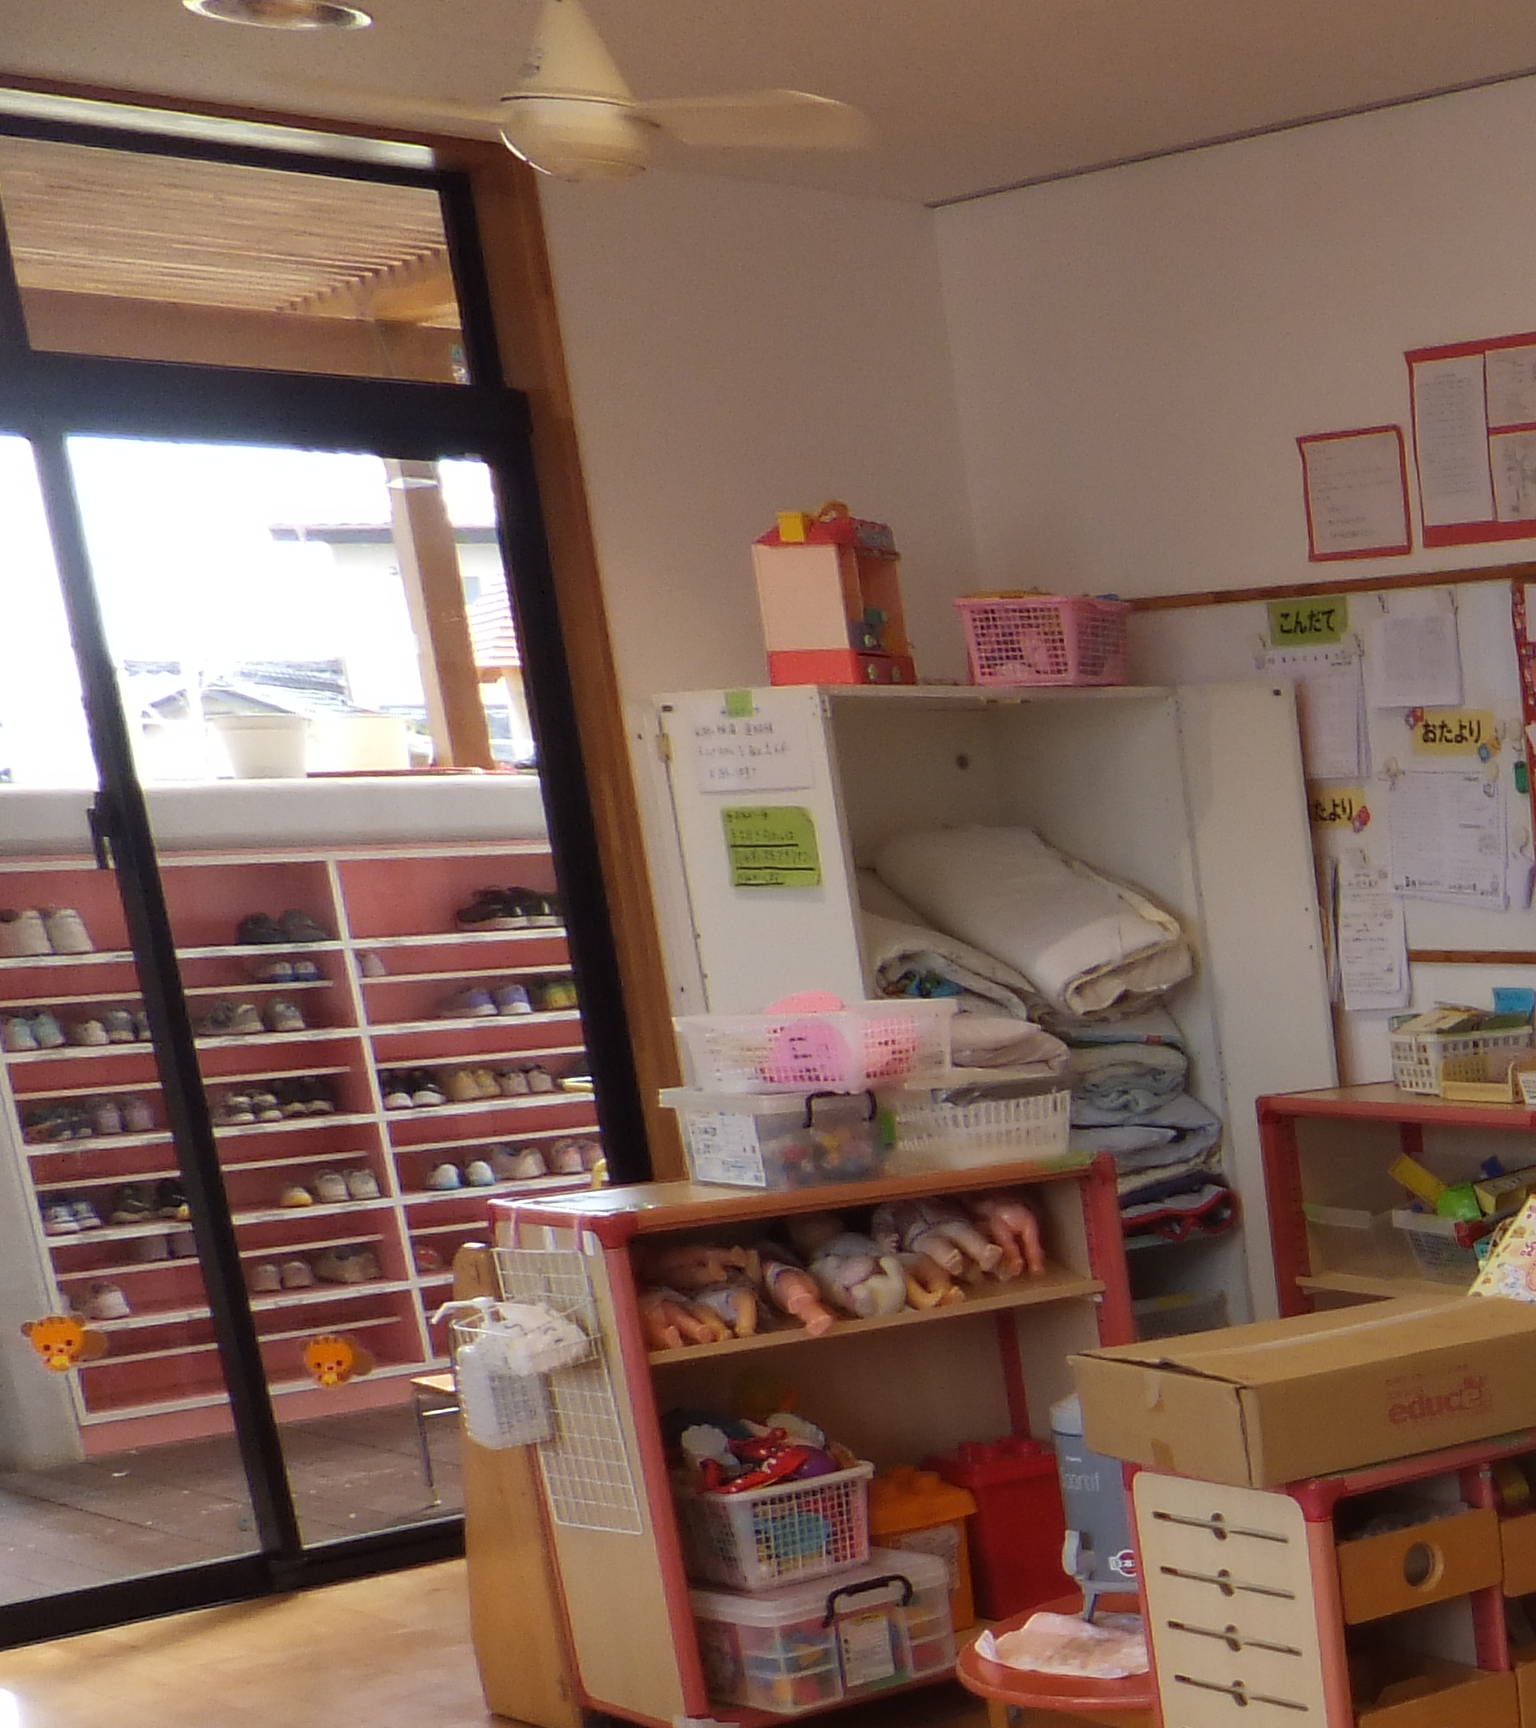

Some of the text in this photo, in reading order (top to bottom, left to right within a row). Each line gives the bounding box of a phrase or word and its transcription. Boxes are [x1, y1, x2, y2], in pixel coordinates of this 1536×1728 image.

[1279, 608, 1336, 635] こんだて
[1421, 718, 1482, 744] おたより
